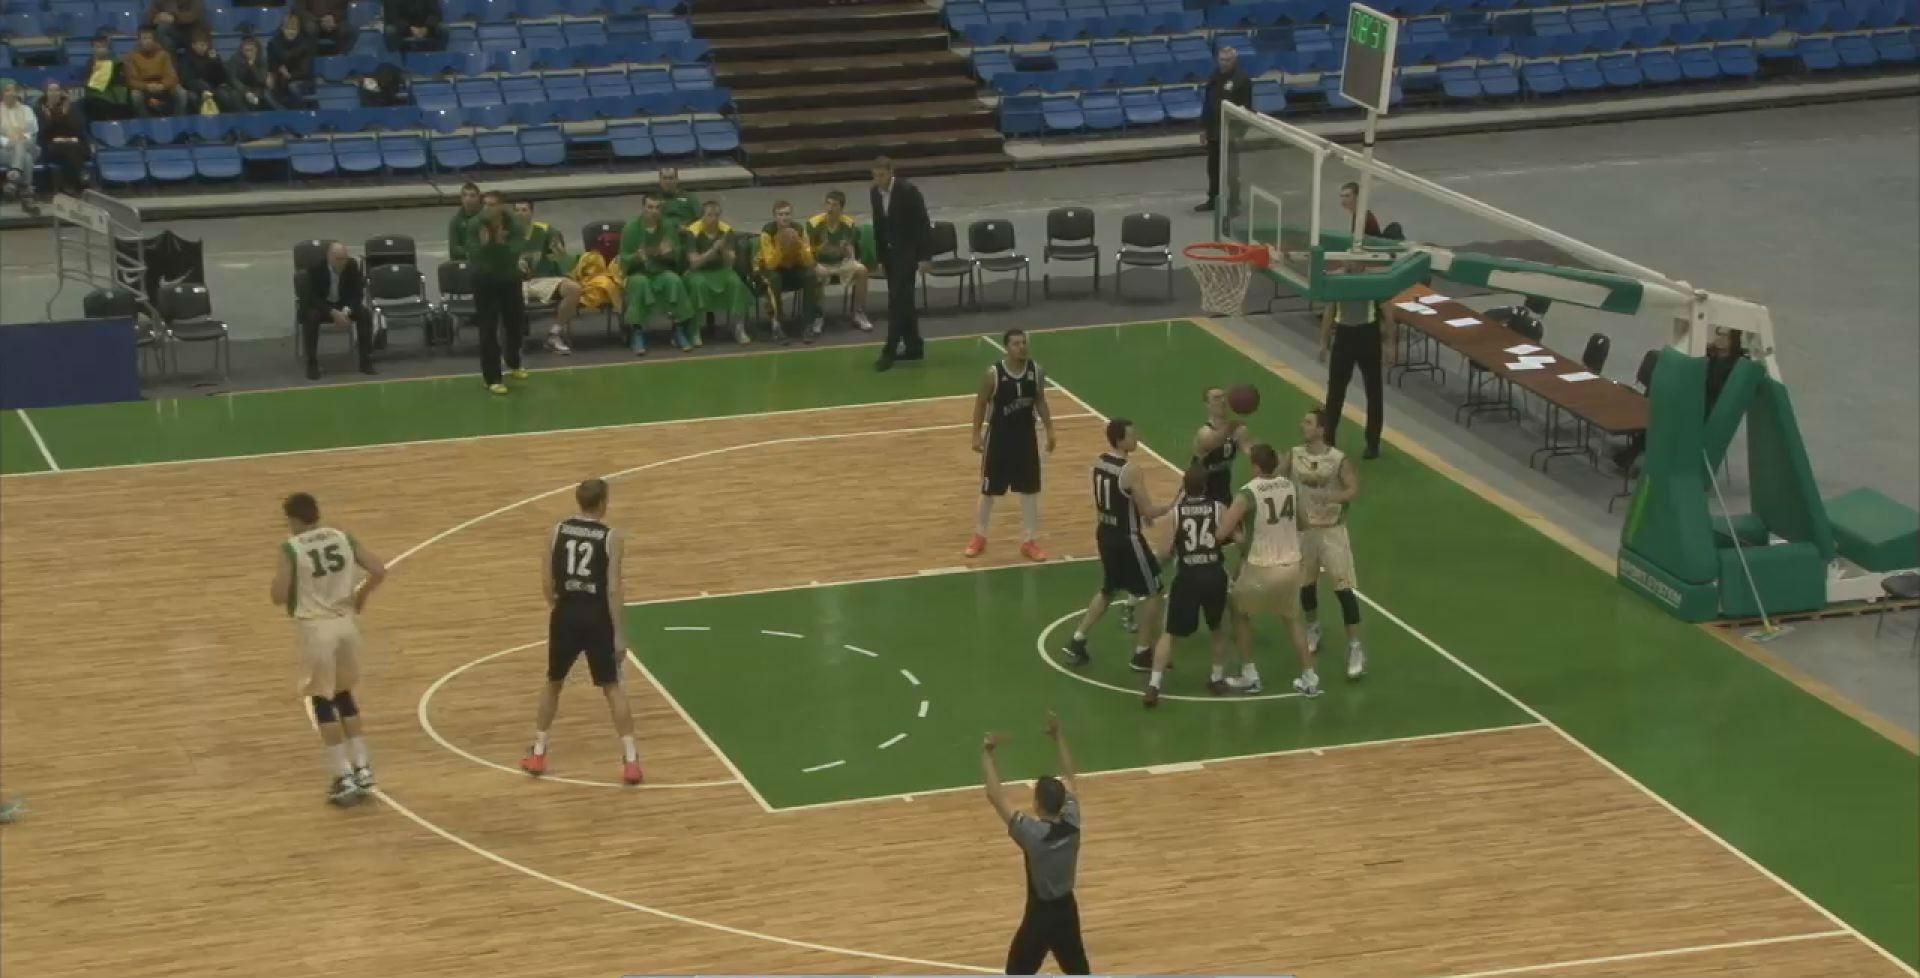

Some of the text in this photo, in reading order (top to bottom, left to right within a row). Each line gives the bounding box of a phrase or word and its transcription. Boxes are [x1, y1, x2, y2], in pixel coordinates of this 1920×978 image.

[1096, 473, 1111, 510] 11
[1263, 494, 1294, 525] 14
[1182, 518, 1215, 551] 34
[306, 545, 345, 577] 15
[566, 540, 593, 576] 12
